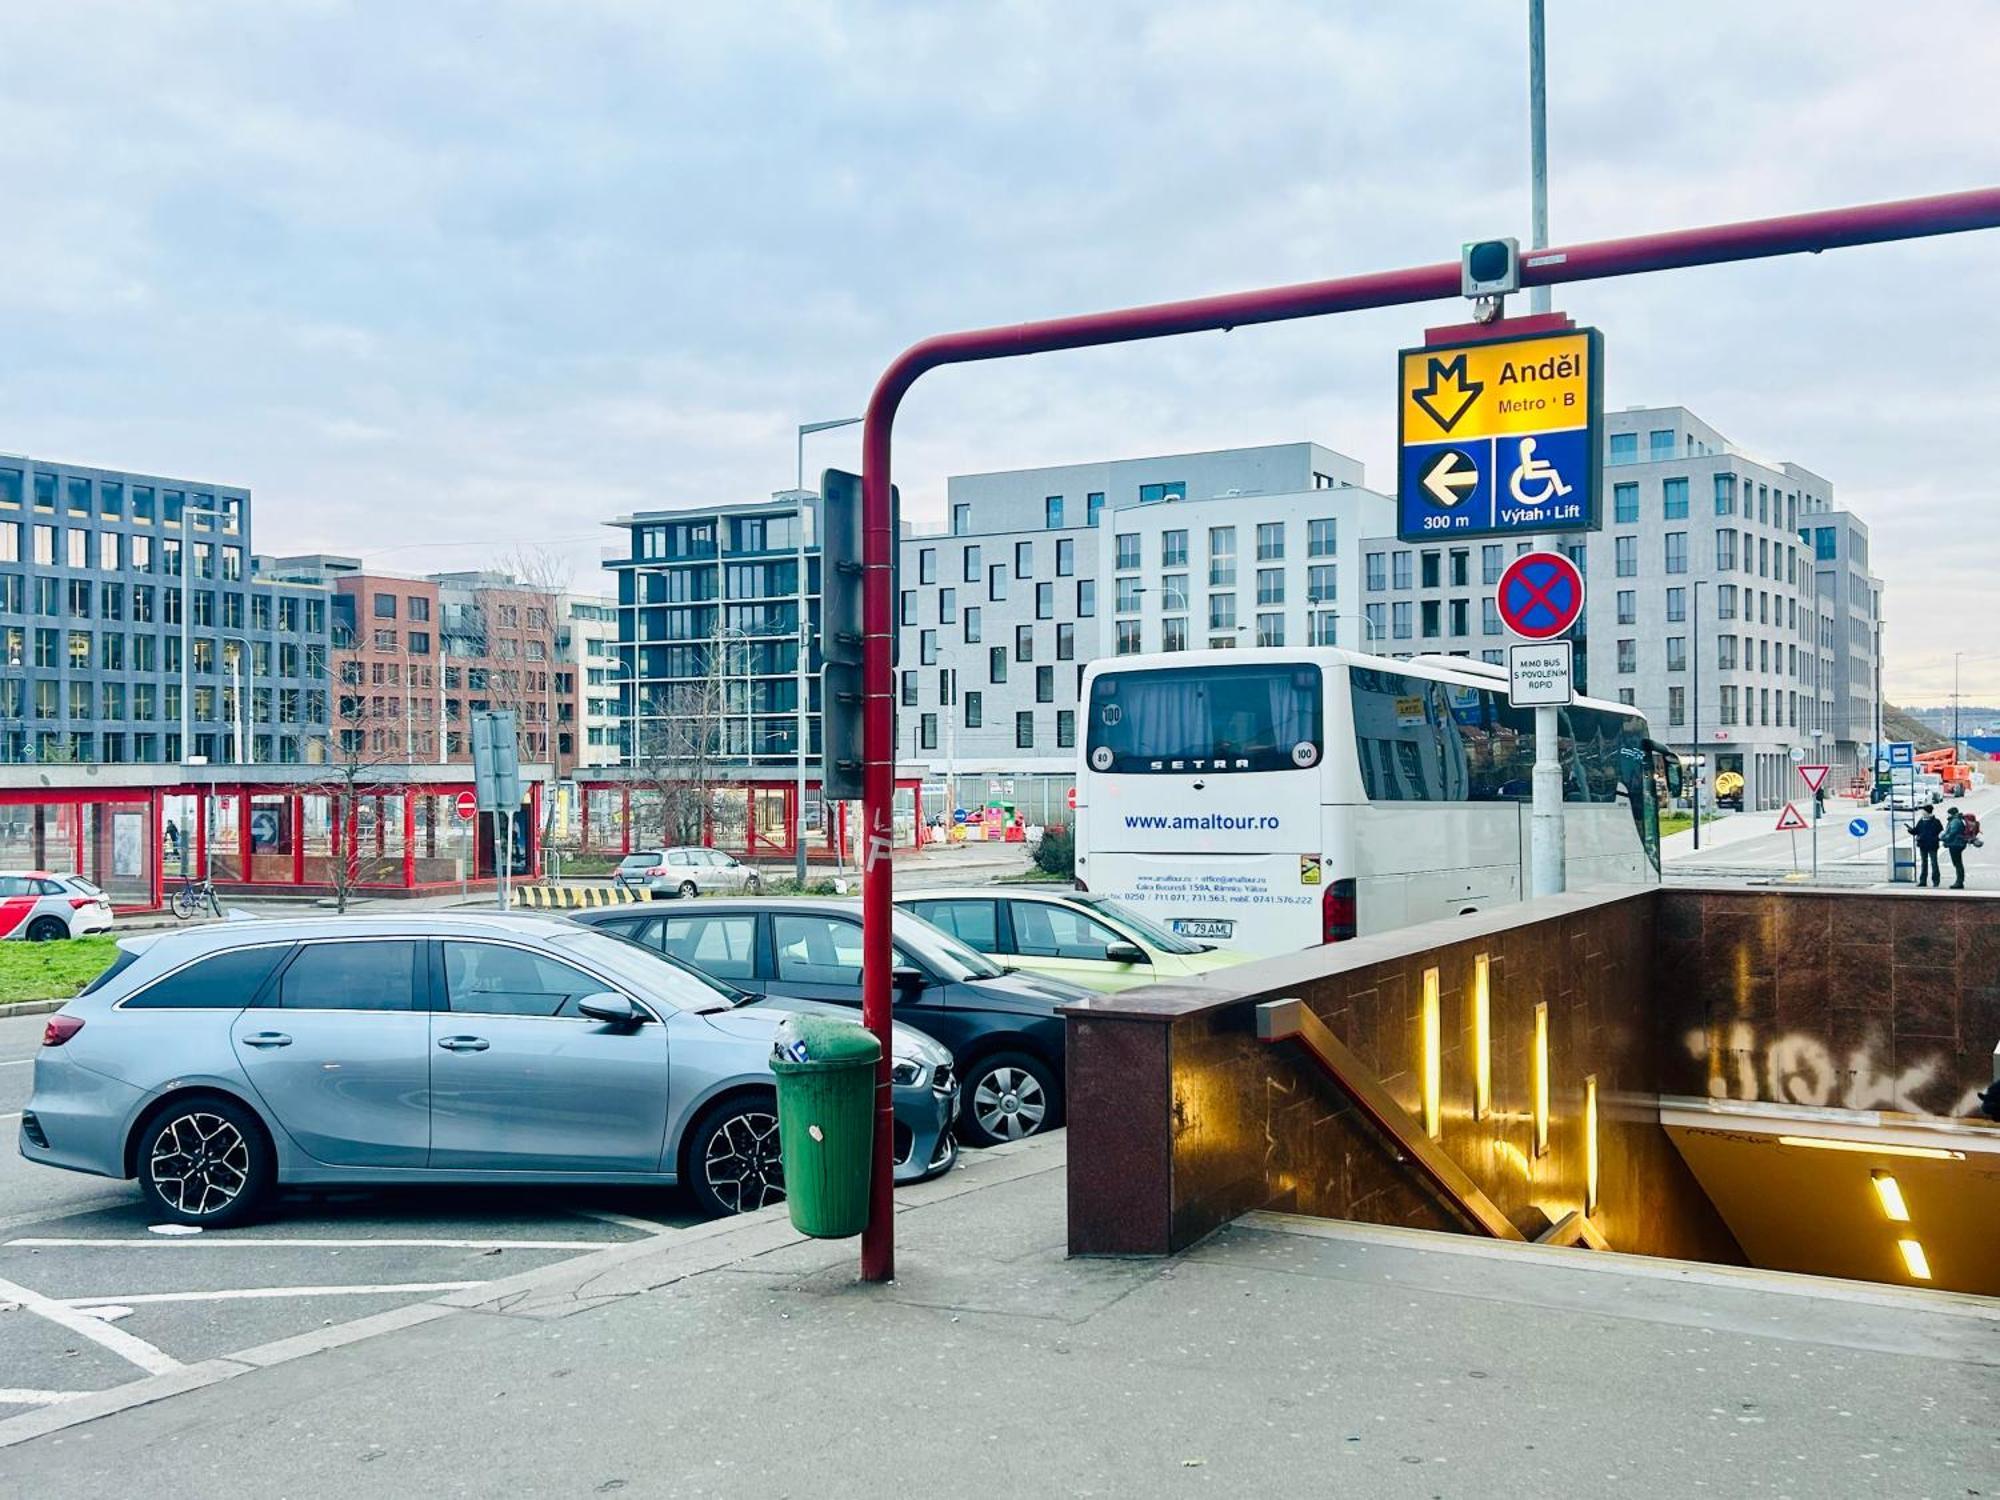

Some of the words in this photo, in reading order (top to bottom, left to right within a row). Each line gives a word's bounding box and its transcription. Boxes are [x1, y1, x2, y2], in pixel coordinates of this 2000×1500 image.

[1499, 353, 1580, 386] Anděl
[1499, 397, 1546, 414] Metro
[1564, 392, 1575, 406] B
[1501, 507, 1543, 525] Výtah
[1554, 504, 1580, 519] Lift
[1423, 515, 1450, 530] 300
[1456, 516, 1469, 527] m
[1520, 659, 1541, 668] MIMO
[1544, 659, 1561, 667] BUS
[1514, 671, 1520, 679] S
[1528, 680, 1553, 689] ROPID
[1297, 749, 1312, 759] 100
[1150, 759, 1249, 770] SETRA
[1125, 813, 1279, 830] www.amaltour.ro
[1195, 923, 1206, 934] 79
